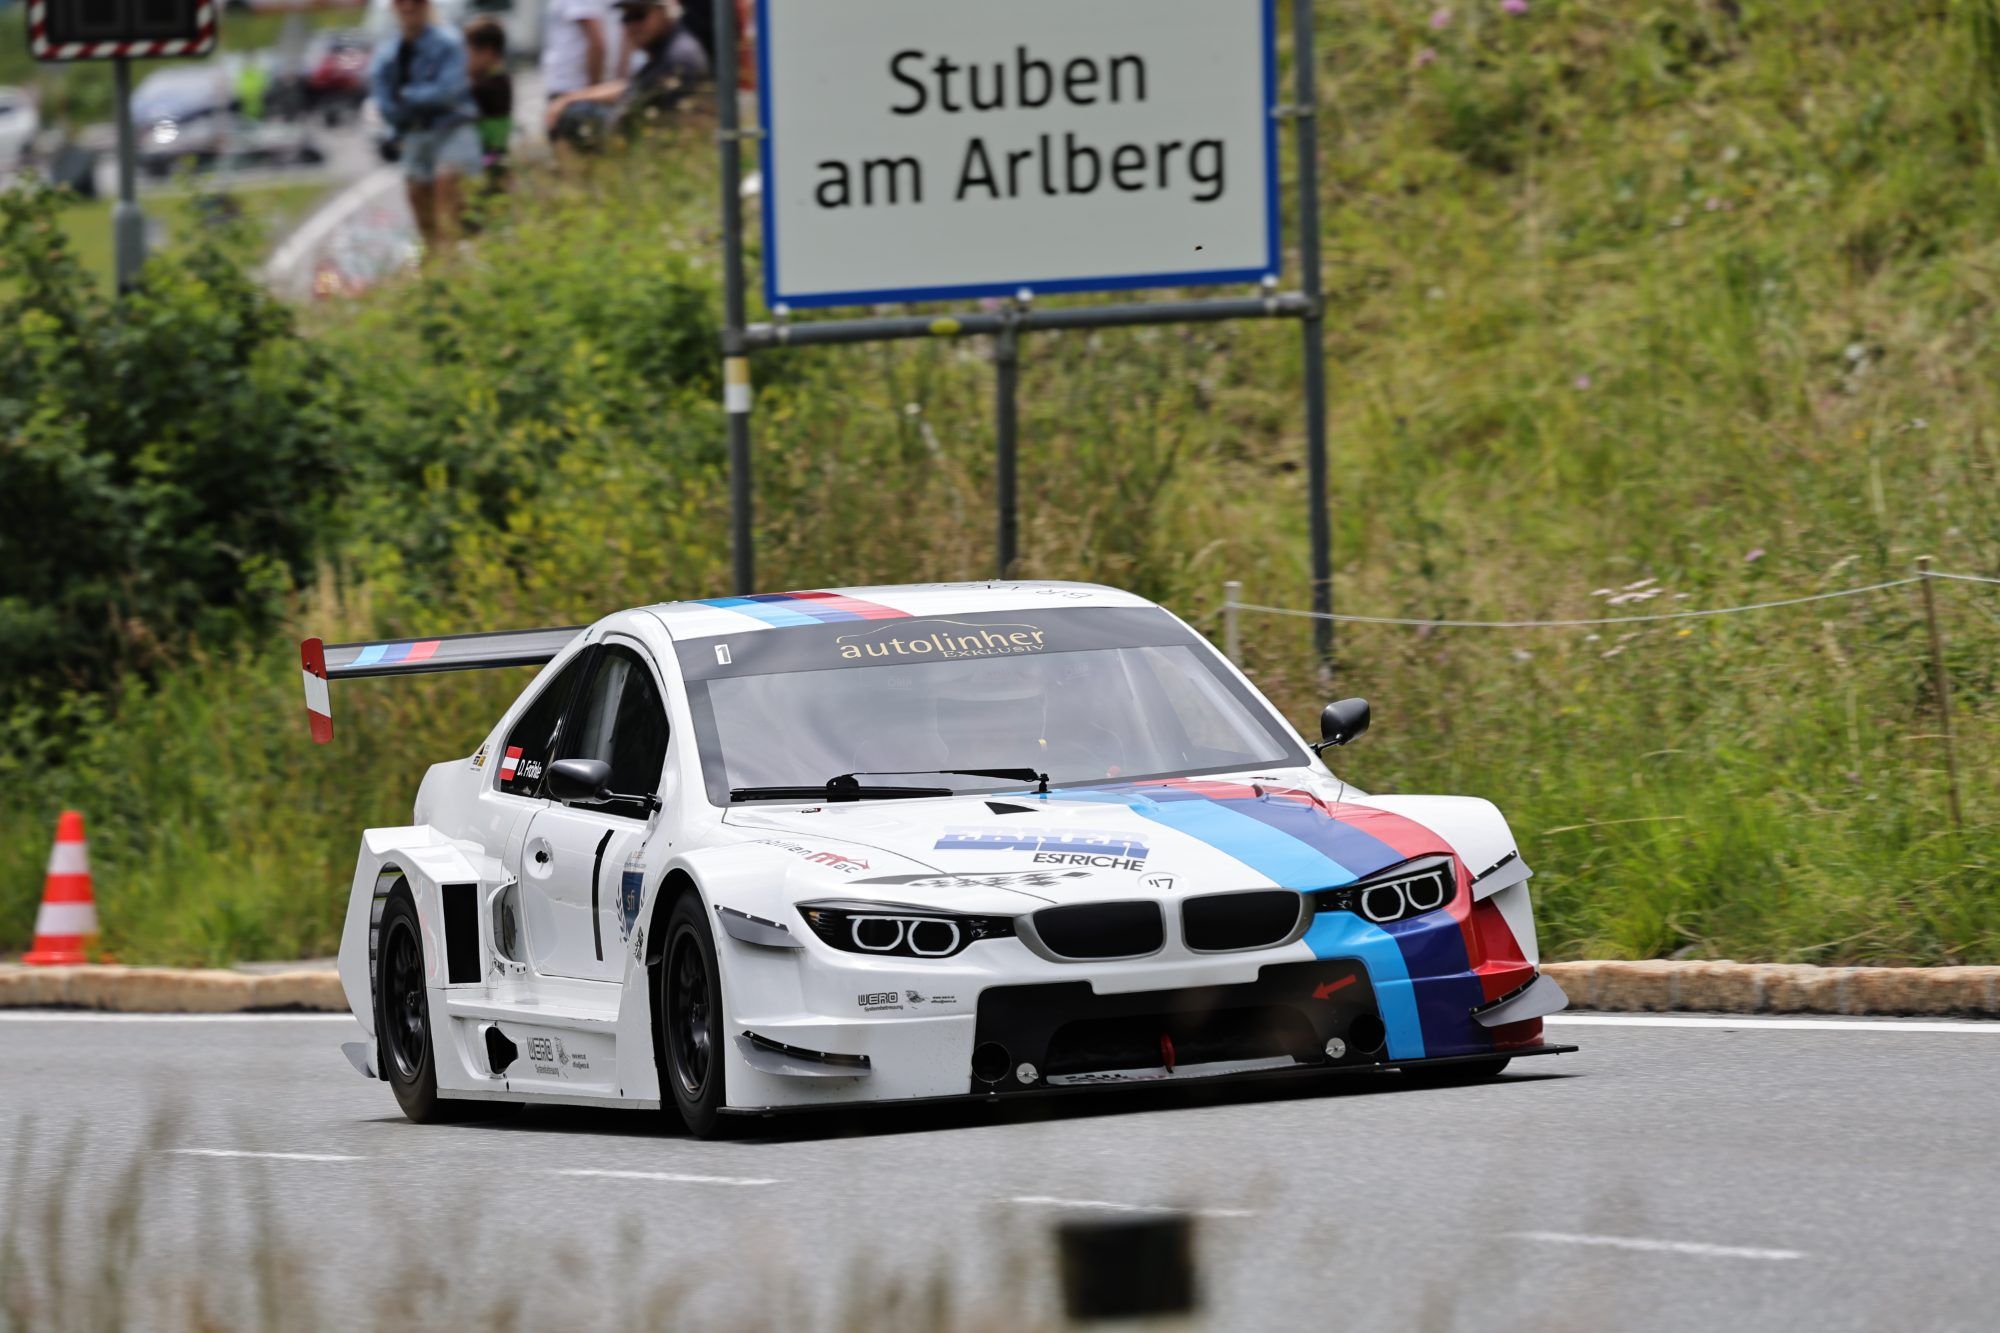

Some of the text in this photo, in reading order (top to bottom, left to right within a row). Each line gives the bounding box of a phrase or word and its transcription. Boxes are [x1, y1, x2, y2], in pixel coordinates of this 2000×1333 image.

[888, 45, 1148, 116] Stuben
[815, 131, 1226, 209] am Arlberg
[839, 630, 1045, 659] autolinher
[942, 644, 1044, 659] EXKLUSIV
[1033, 853, 1146, 872] ESTRICHE
[592, 829, 615, 962] 1
[858, 992, 898, 1006] WERO
